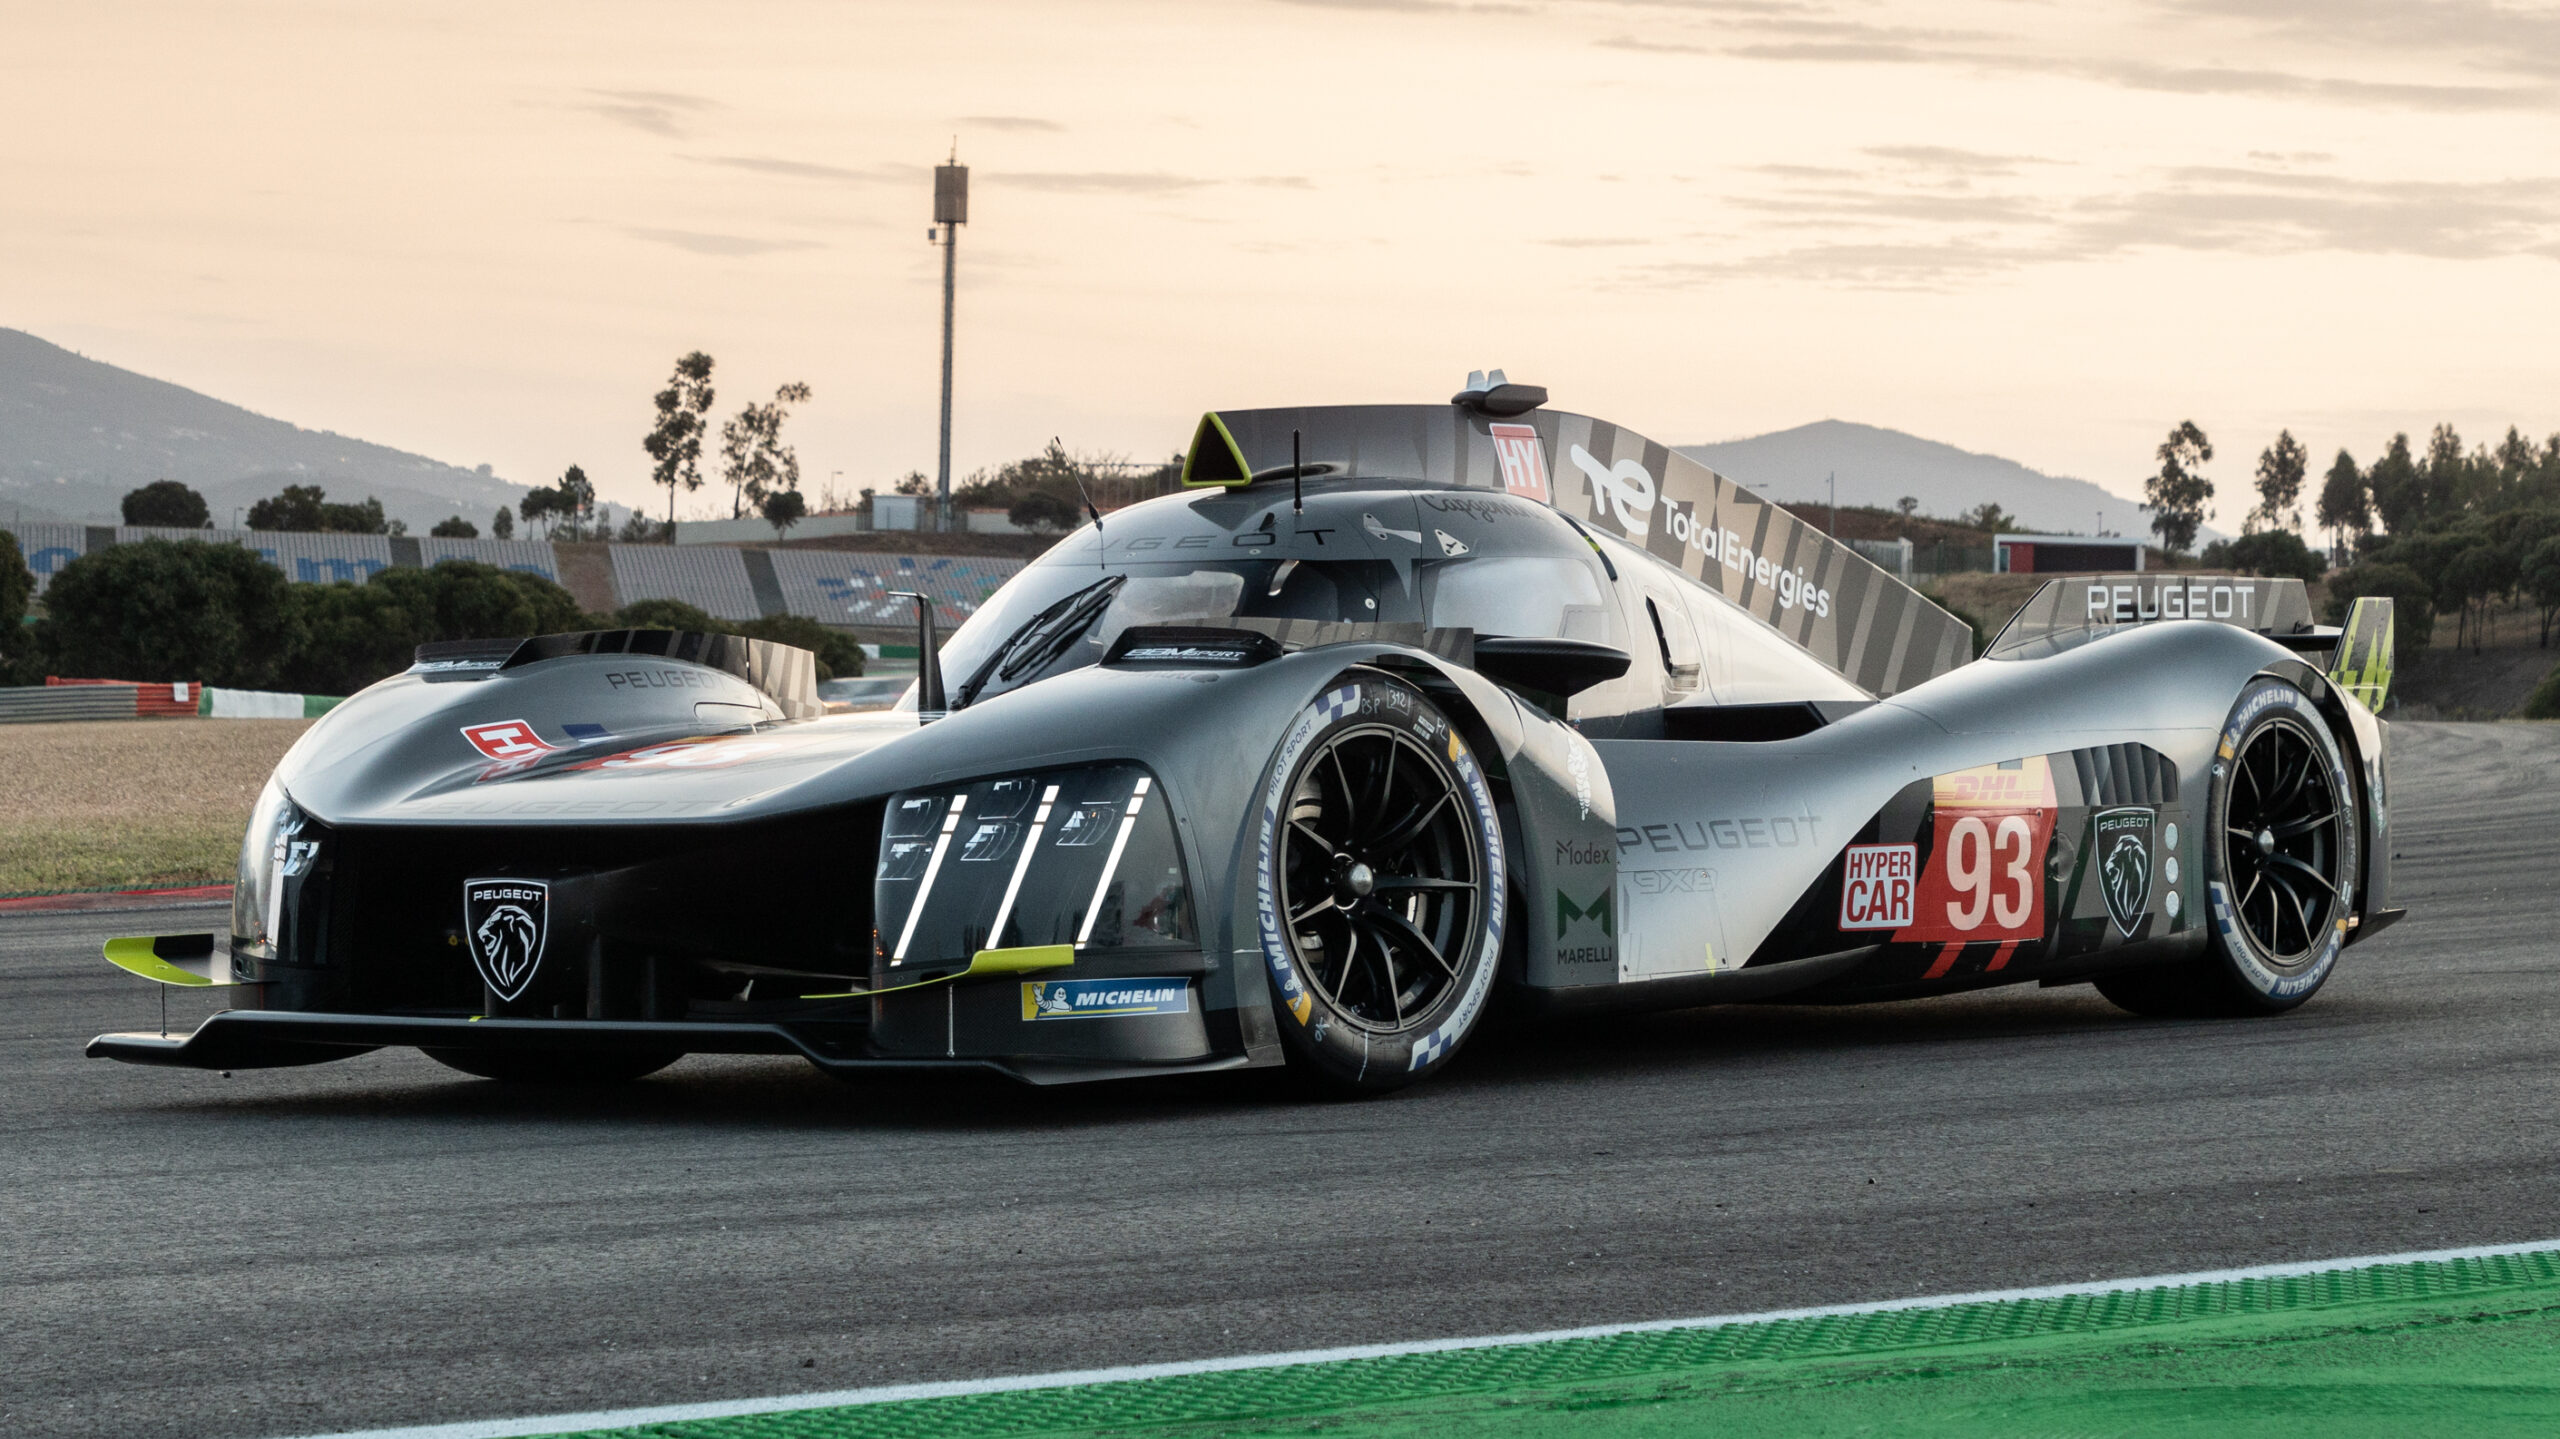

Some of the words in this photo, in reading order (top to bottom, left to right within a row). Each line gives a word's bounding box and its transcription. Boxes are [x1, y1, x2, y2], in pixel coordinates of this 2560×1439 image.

[1498, 438, 1537, 489] HY
[1660, 494, 1830, 618] TotalEnergies
[2087, 585, 2255, 619] PEUGEOT
[605, 670, 729, 690] PEUGEOT
[2238, 689, 2294, 727] MICHELIN
[1269, 755, 1289, 798] PILOT
[1286, 718, 1313, 758] SPORT
[1954, 775, 2024, 800] DHL
[1616, 816, 1822, 855] PEUGEOT
[2101, 816, 2150, 833] PEUGEOT
[1470, 777, 1504, 925] MICHELIN
[1556, 839, 1610, 865] Modex
[1849, 851, 1911, 879] HYPER
[1946, 816, 2034, 931] 93
[473, 889, 543, 902] PEUGEOT
[1258, 822, 1289, 970] MICHELIN
[1846, 880, 1910, 923] CAR
[1479, 947, 1495, 989] PILOT
[1557, 946, 1612, 964] MARELLI
[2277, 950, 2333, 996] MICHELIN
[1075, 987, 1175, 1007] MICHELIN
[1457, 989, 1484, 1029] SPORT
